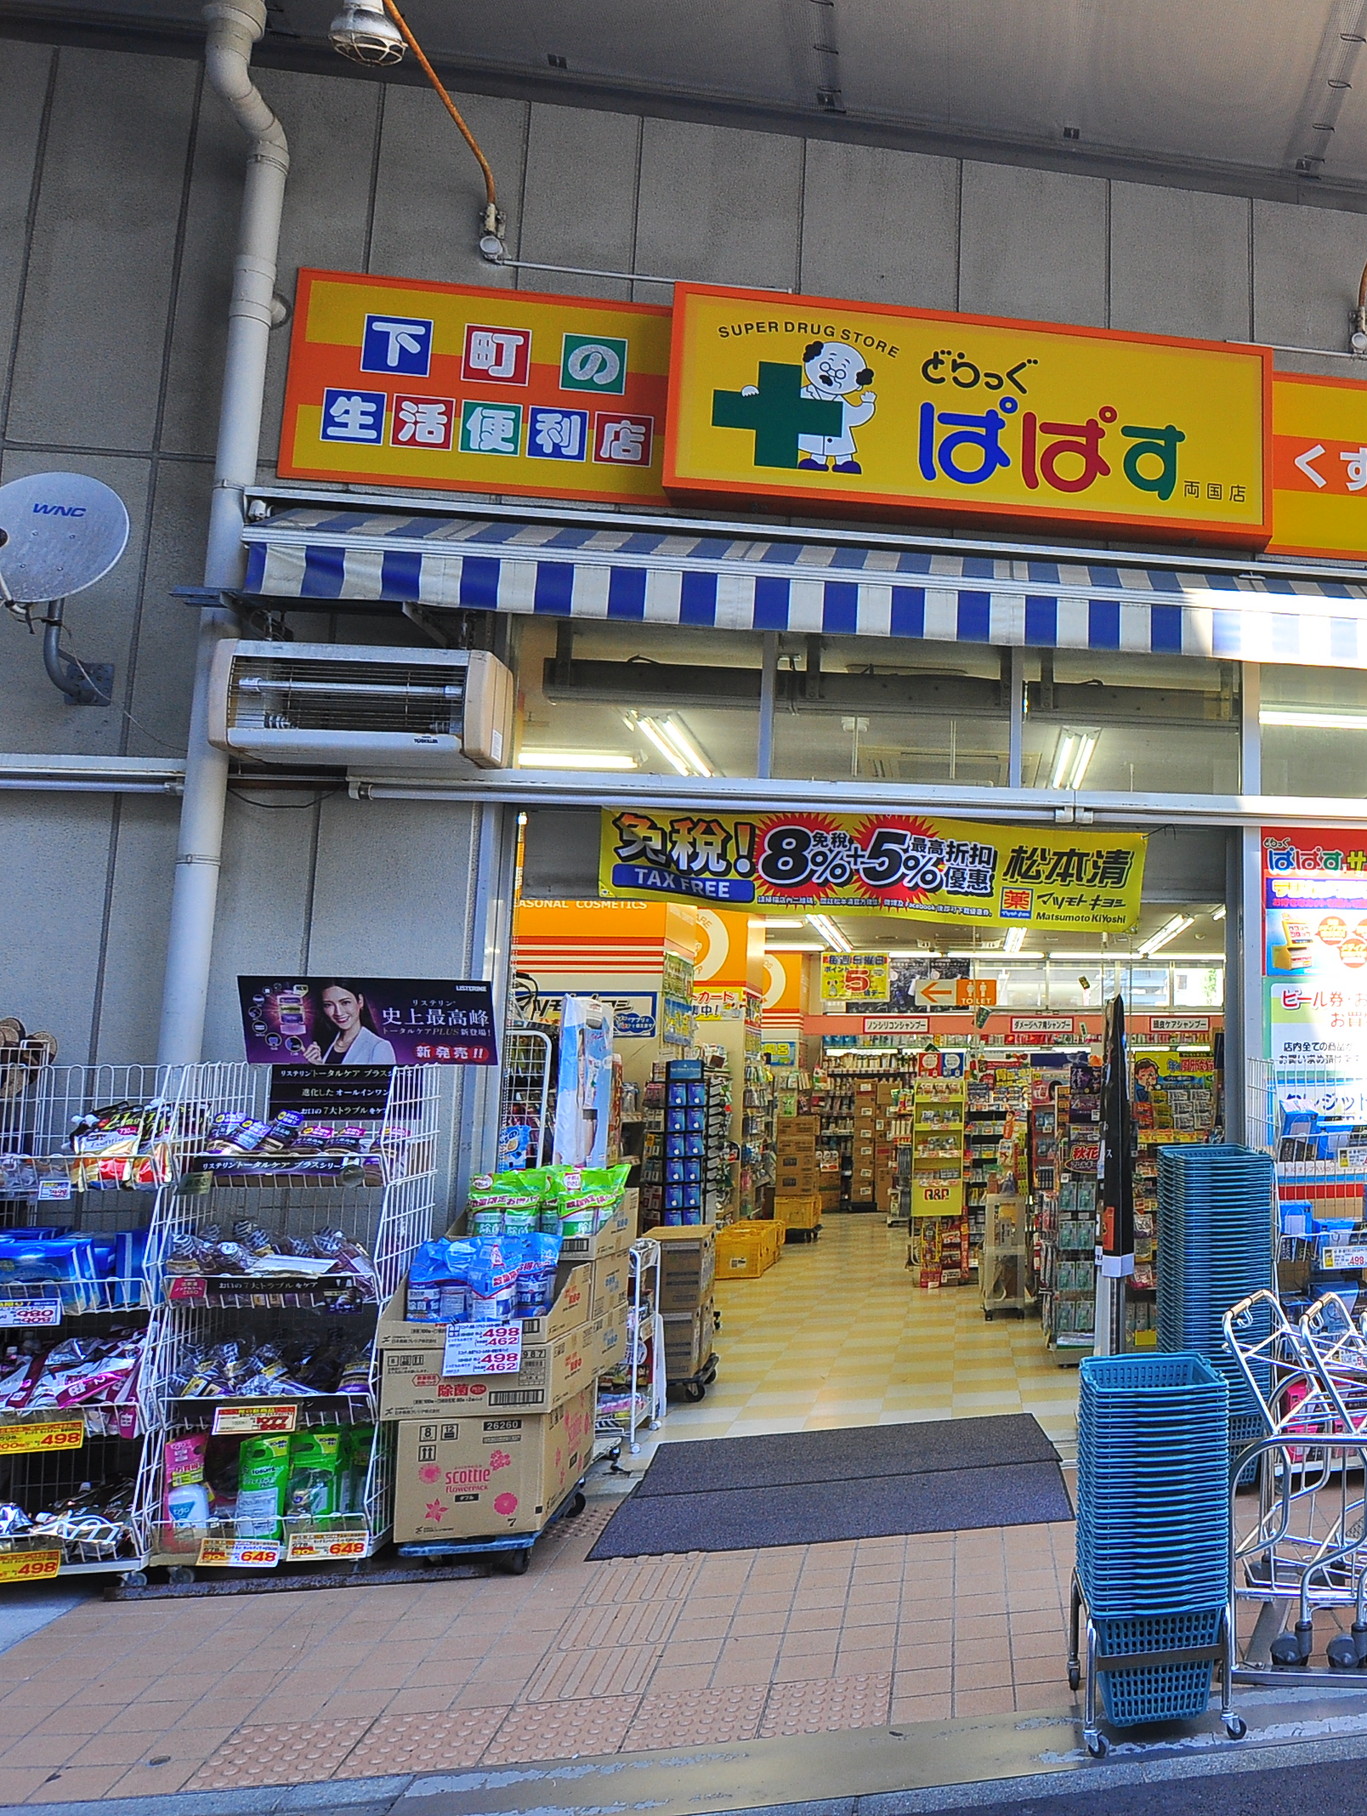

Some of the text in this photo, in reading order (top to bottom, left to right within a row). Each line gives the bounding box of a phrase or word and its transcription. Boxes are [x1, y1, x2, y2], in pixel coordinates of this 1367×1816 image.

[718, 321, 900, 359] SUPER DRUG STORE
[372, 320, 620, 386] 下町の
[921, 349, 1038, 395] どらっぐ
[329, 396, 645, 461] 生活便利店
[918, 396, 1186, 501] ぱぱす
[1183, 480, 1247, 503] 両国店
[33, 503, 87, 517] WNC
[1268, 847, 1344, 872] ぱぱす
[1002, 845, 1134, 889] 松本清
[634, 868, 730, 898] TAX FREE
[944, 868, 992, 894] 優惠
[1036, 912, 1090, 923] Matsumoto
[844, 969, 870, 992] 5
[961, 997, 992, 1005] TOLET
[382, 1007, 489, 1027] 史上最高峰
[483, 1327, 520, 1338] 498
[488, 1337, 518, 1345] 462
[481, 1353, 518, 1363] 498
[486, 1363, 516, 1371] 462
[438, 1384, 469, 1397] 除菌
[487, 1421, 519, 1430] 26260
[41, 1432, 81, 1445] 498
[424, 1428, 431, 1438] 8
[507, 1517, 517, 1527] 7
[329, 1543, 365, 1554] 648
[241, 1551, 277, 1561] 648
[18, 1562, 57, 1574] 498
